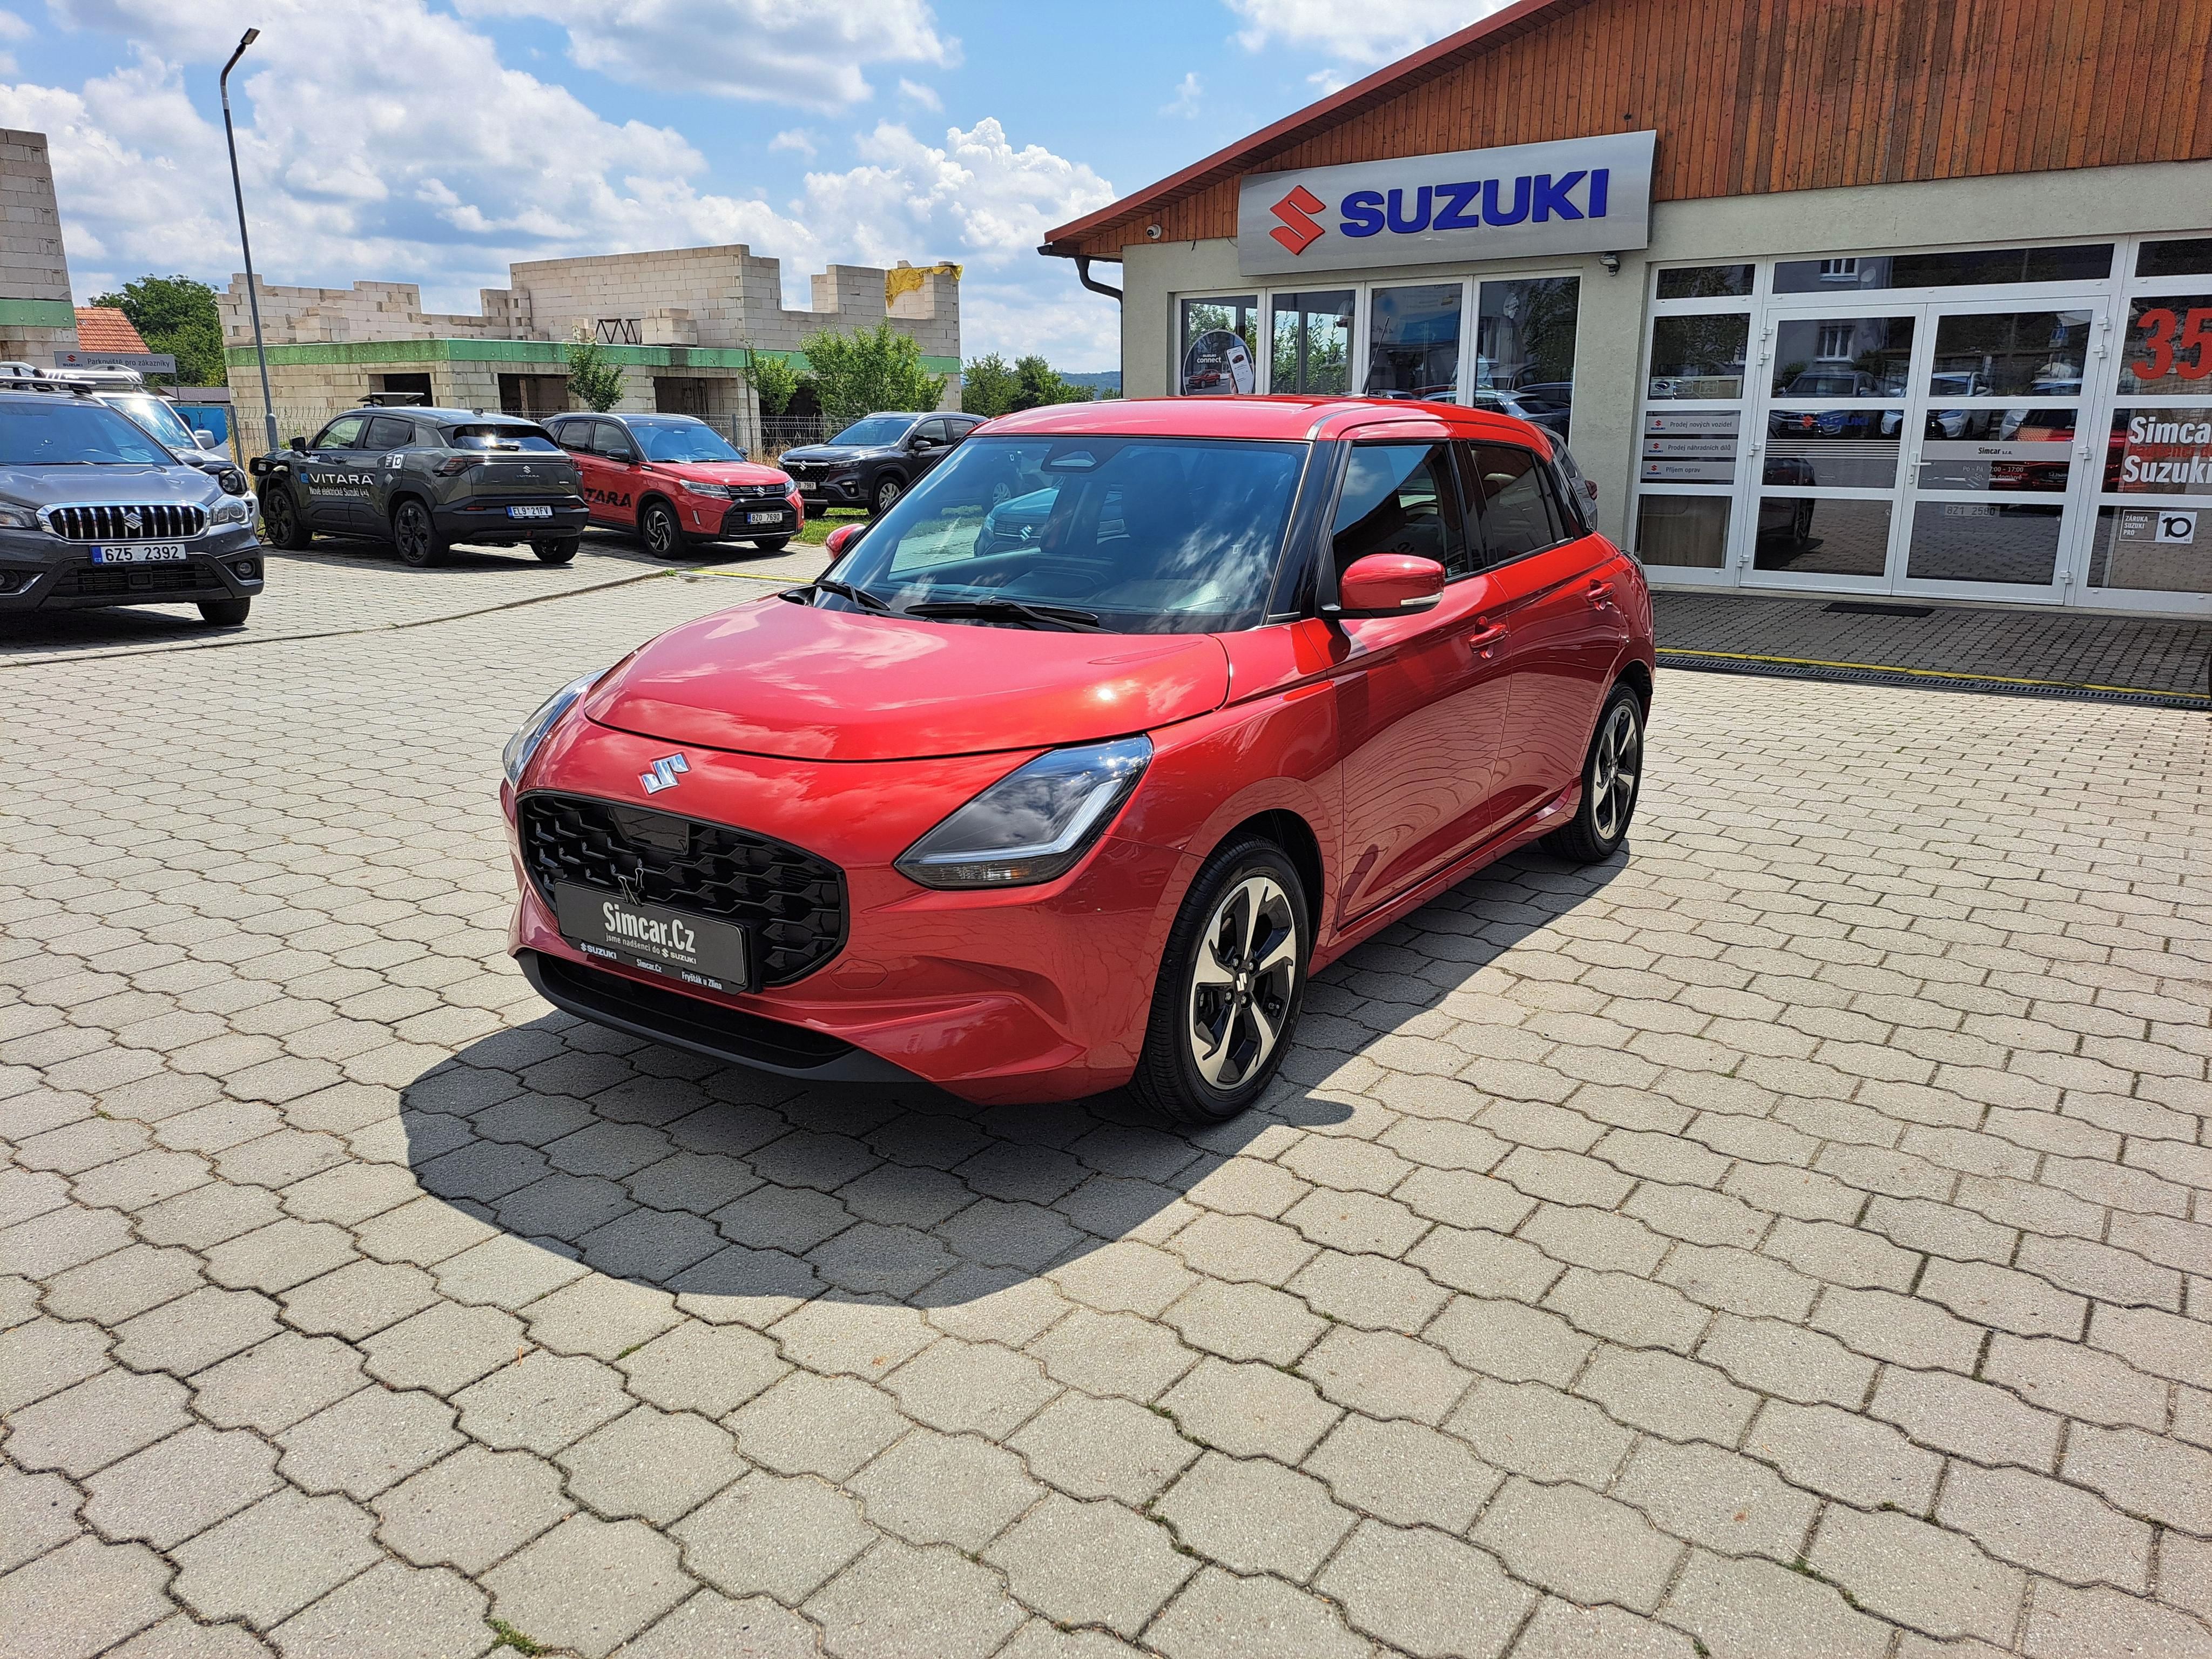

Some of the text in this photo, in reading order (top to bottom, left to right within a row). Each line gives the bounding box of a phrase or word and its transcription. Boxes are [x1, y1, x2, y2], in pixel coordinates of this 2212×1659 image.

[1340, 168, 1609, 238] SUZUKI
[2132, 308, 2212, 380] 35
[138, 359, 170, 368] zákazníky
[2128, 416, 2212, 444] Simca
[2122, 455, 2212, 484] Suzuki
[309, 487, 321, 495] Nové
[322, 487, 343, 496] elektrické
[343, 488, 360, 496] Suzuki
[584, 488, 632, 508] TARA
[2126, 514, 2148, 522] ZÁRUKA
[2161, 517, 2192, 538] 10
[105, 546, 179, 562] 6Z5 2392
[603, 902, 696, 953] Simcar.Cz
[587, 945, 617, 960] SUZUKI
[605, 932, 697, 965] jsme nadšenci do SUZUKI
[636, 959, 662, 973] Simcar.Cz
[682, 971, 703, 984] Fryšták
[708, 979, 723, 990] Zlína
